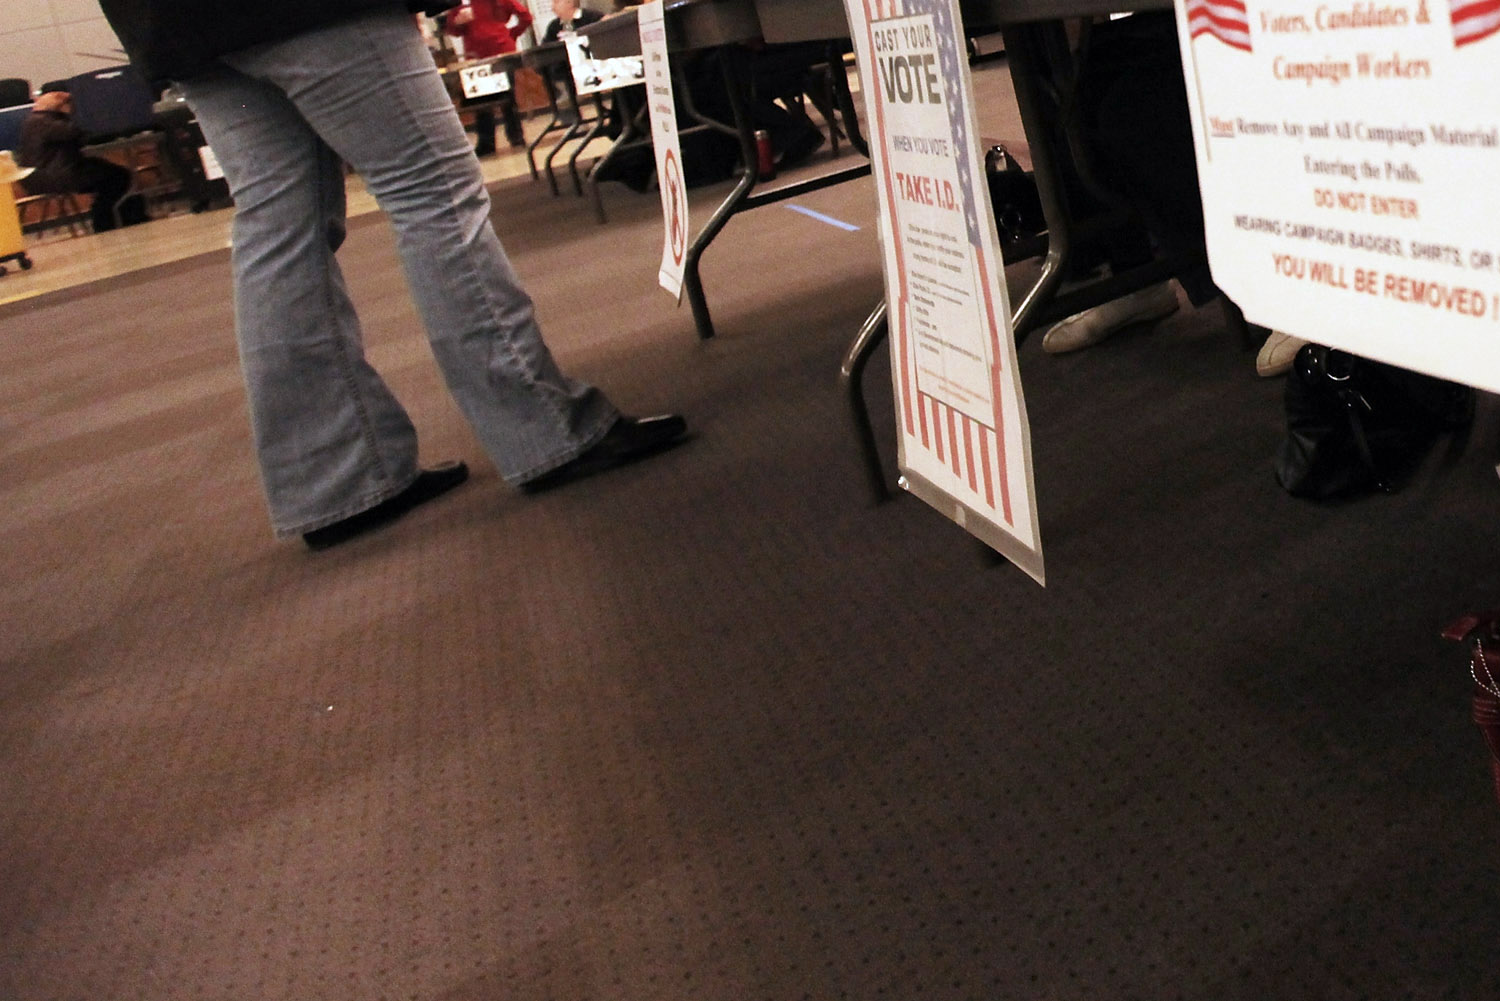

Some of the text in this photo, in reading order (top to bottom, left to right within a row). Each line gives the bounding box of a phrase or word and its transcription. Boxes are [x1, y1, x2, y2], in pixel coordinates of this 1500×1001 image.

[1260, 10, 1312, 35] Voters,
[1315, 2, 1409, 32] Candidates
[874, 23, 933, 53] CAST YOUR
[878, 53, 942, 105] VOTE
[1273, 50, 1432, 88] Campaign Workers
[928, 137, 949, 158] VOTE
[1236, 117, 1278, 136] Remove
[1308, 119, 1331, 140] and
[1354, 122, 1426, 148] Campaign
[1430, 123, 1499, 148] Material
[1304, 154, 1358, 182] Entering
[1360, 160, 1381, 180] the
[896, 171, 961, 213] TAKE I.D.
[1314, 188, 1418, 220] DO NOT ENTER
[1233, 214, 1282, 236] WEARING
[1284, 220, 1346, 246] CAMPAIGN
[1469, 249, 1494, 272] OR
[1272, 252, 1306, 281] YOU
[1310, 259, 1348, 291] WILL
[1354, 267, 1379, 297] BE
[1383, 273, 1487, 319] REMOVED
